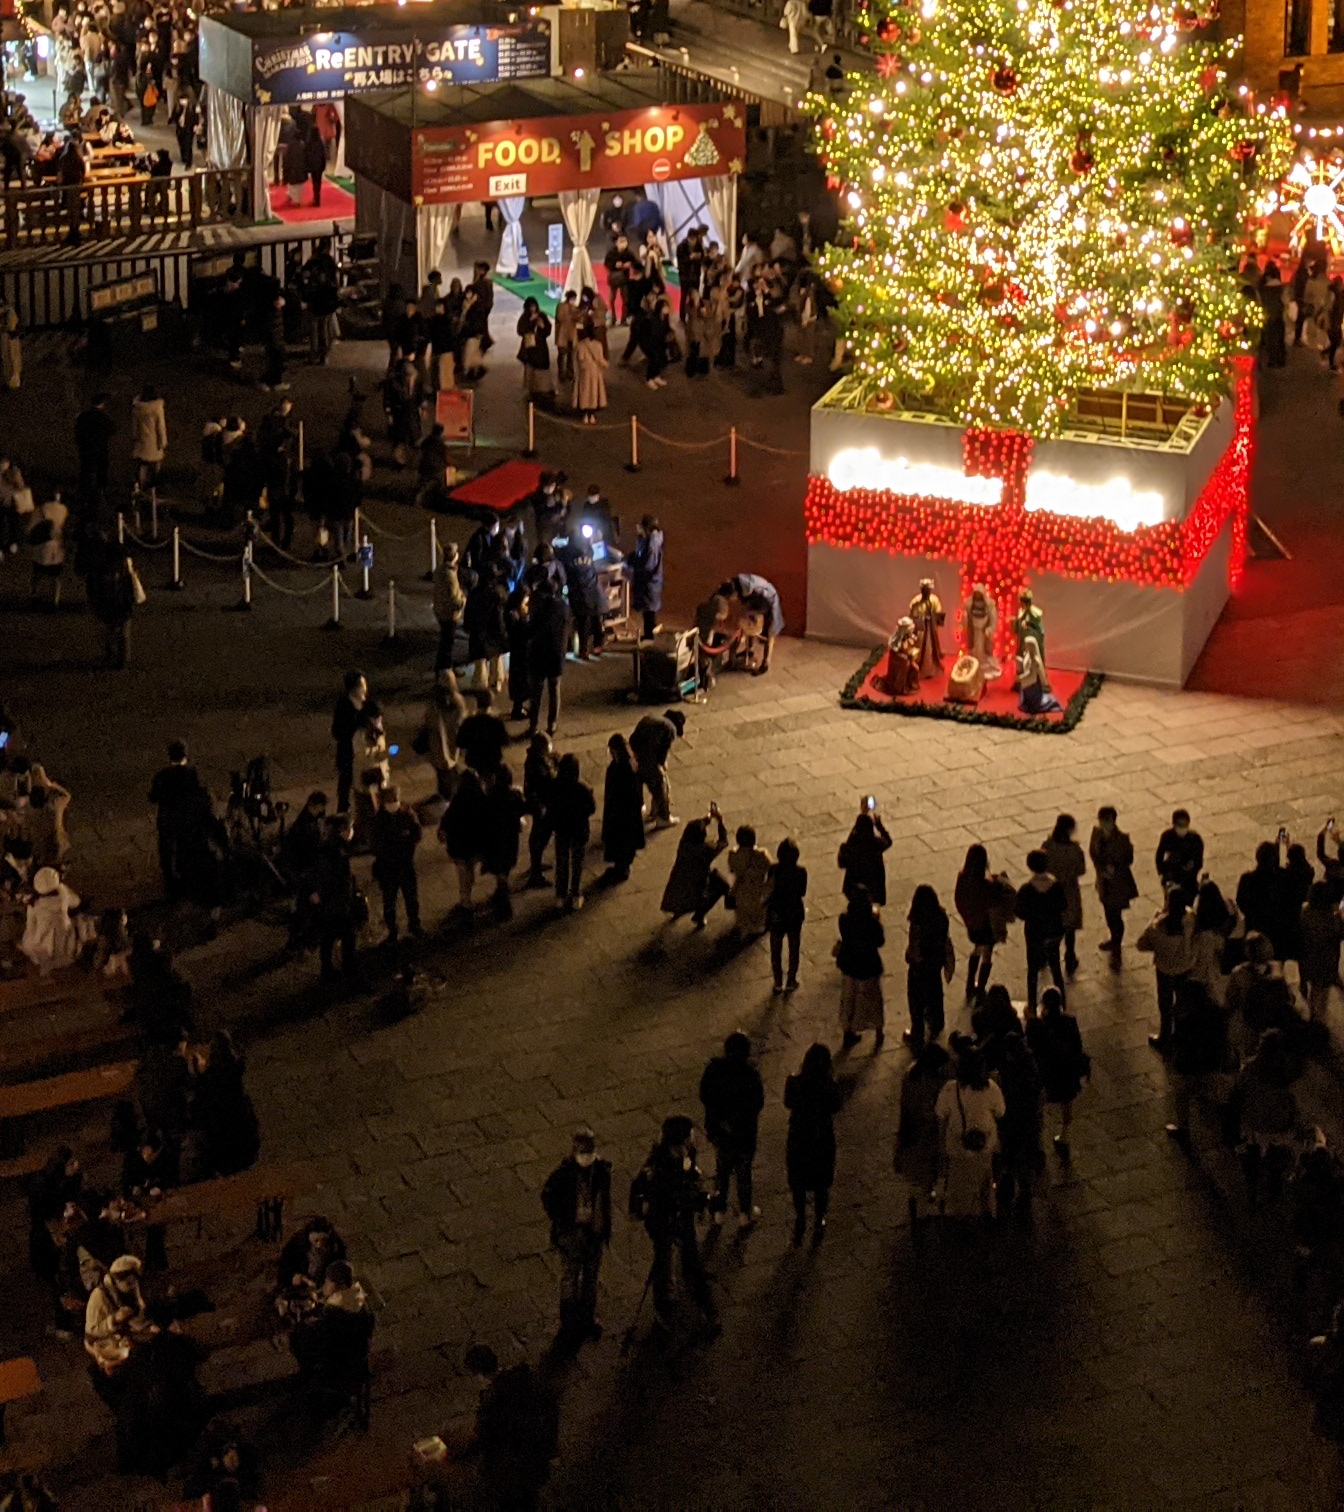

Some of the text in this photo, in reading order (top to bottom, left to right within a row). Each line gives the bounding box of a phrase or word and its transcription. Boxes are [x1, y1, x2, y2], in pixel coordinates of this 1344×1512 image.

[315, 45, 413, 70] ReENTRY
[426, 38, 482, 65] GATE
[477, 124, 685, 170] FOOD SHOP
[494, 177, 521, 193] Exit
